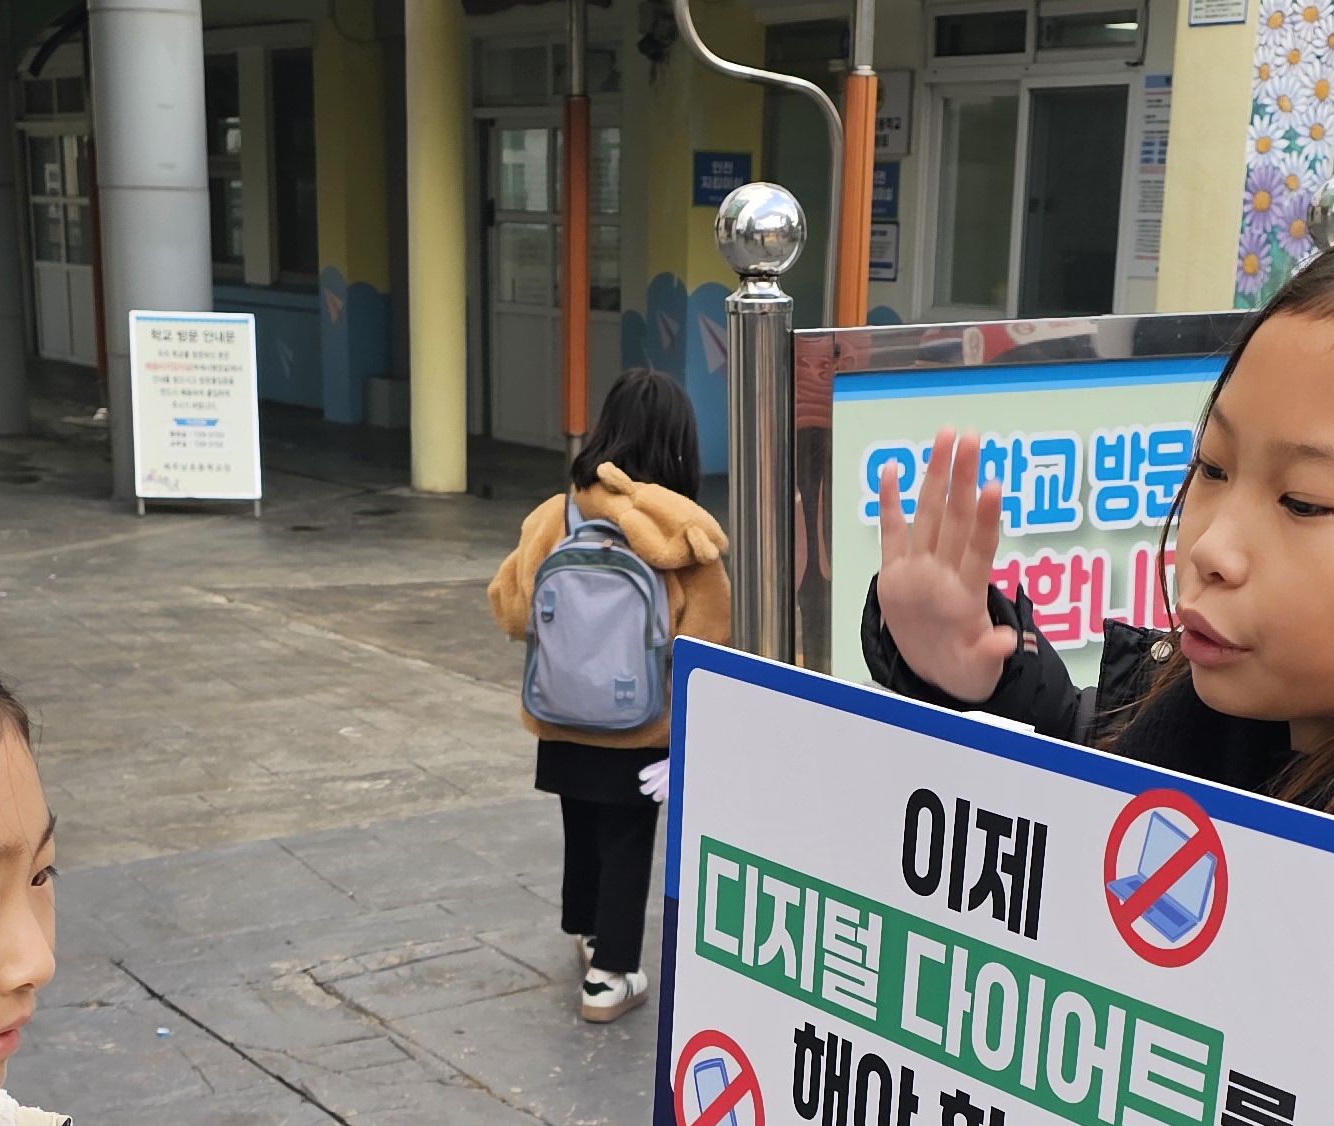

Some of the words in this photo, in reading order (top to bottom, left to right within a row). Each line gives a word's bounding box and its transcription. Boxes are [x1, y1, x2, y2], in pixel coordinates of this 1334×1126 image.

[151, 328, 172, 341] 학교
[177, 329, 198, 343] 방문
[203, 330, 235, 344] 안내문
[703, 852, 884, 1021] 디지털
[902, 788, 1048, 941] 이제
